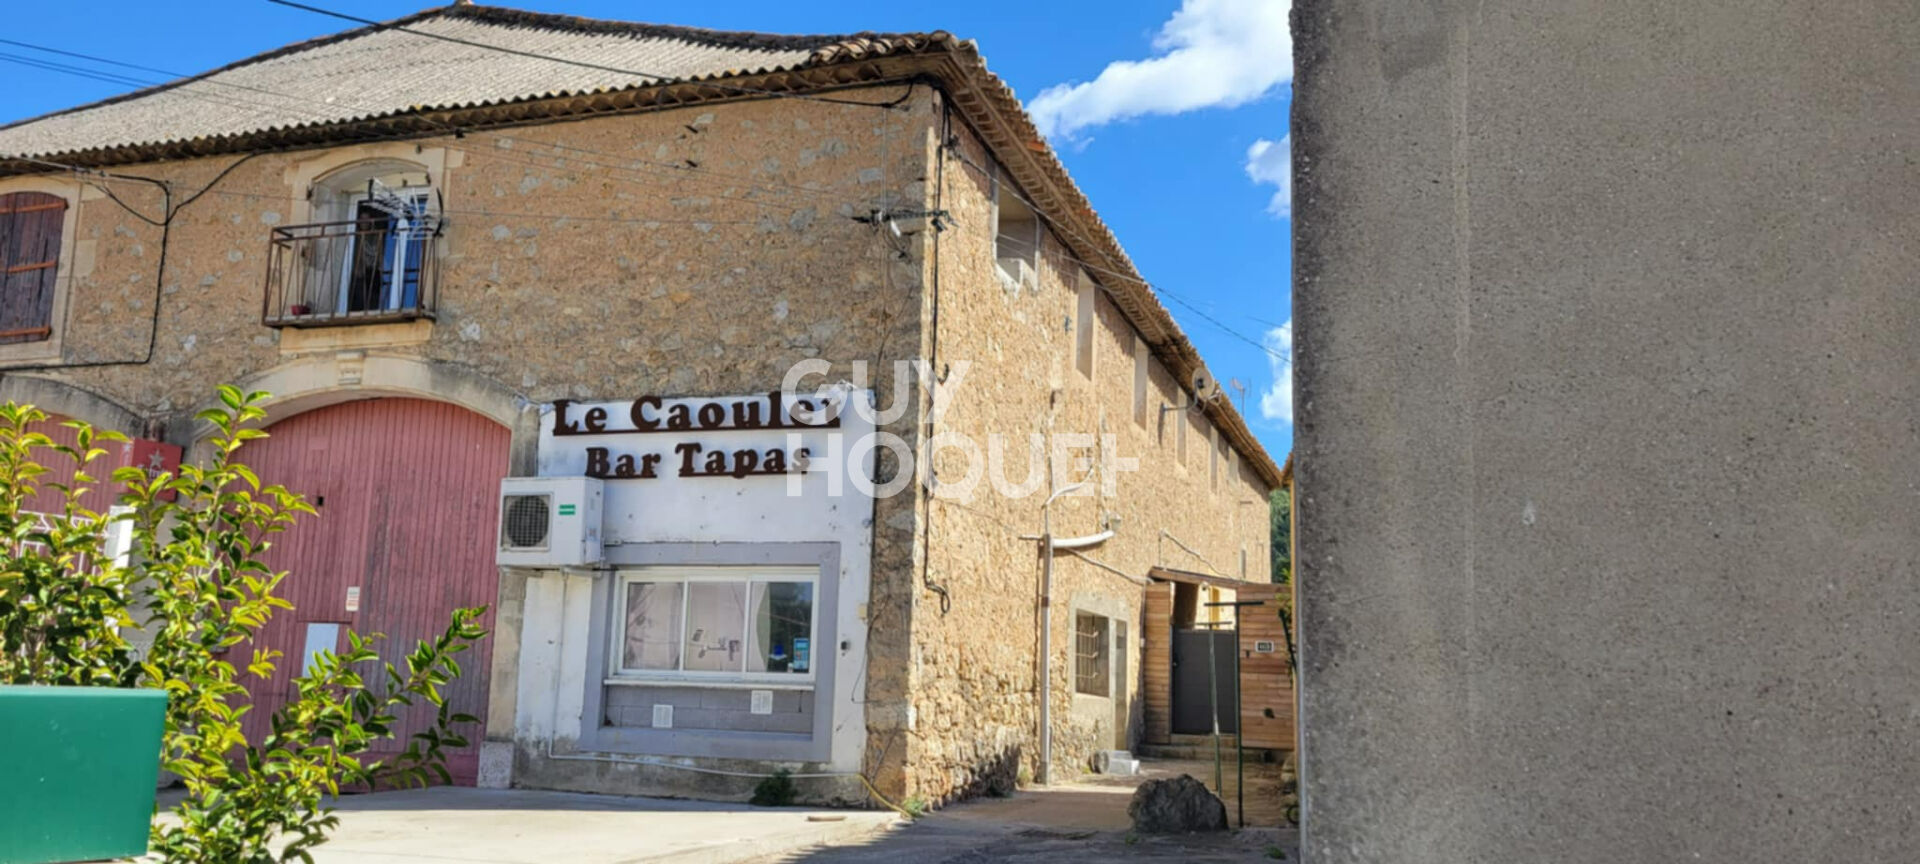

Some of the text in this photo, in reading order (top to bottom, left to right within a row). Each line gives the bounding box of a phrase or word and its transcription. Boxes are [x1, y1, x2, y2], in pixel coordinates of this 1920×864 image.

[553, 399, 608, 435] Le
[585, 442, 811, 479] Bar Tapas
